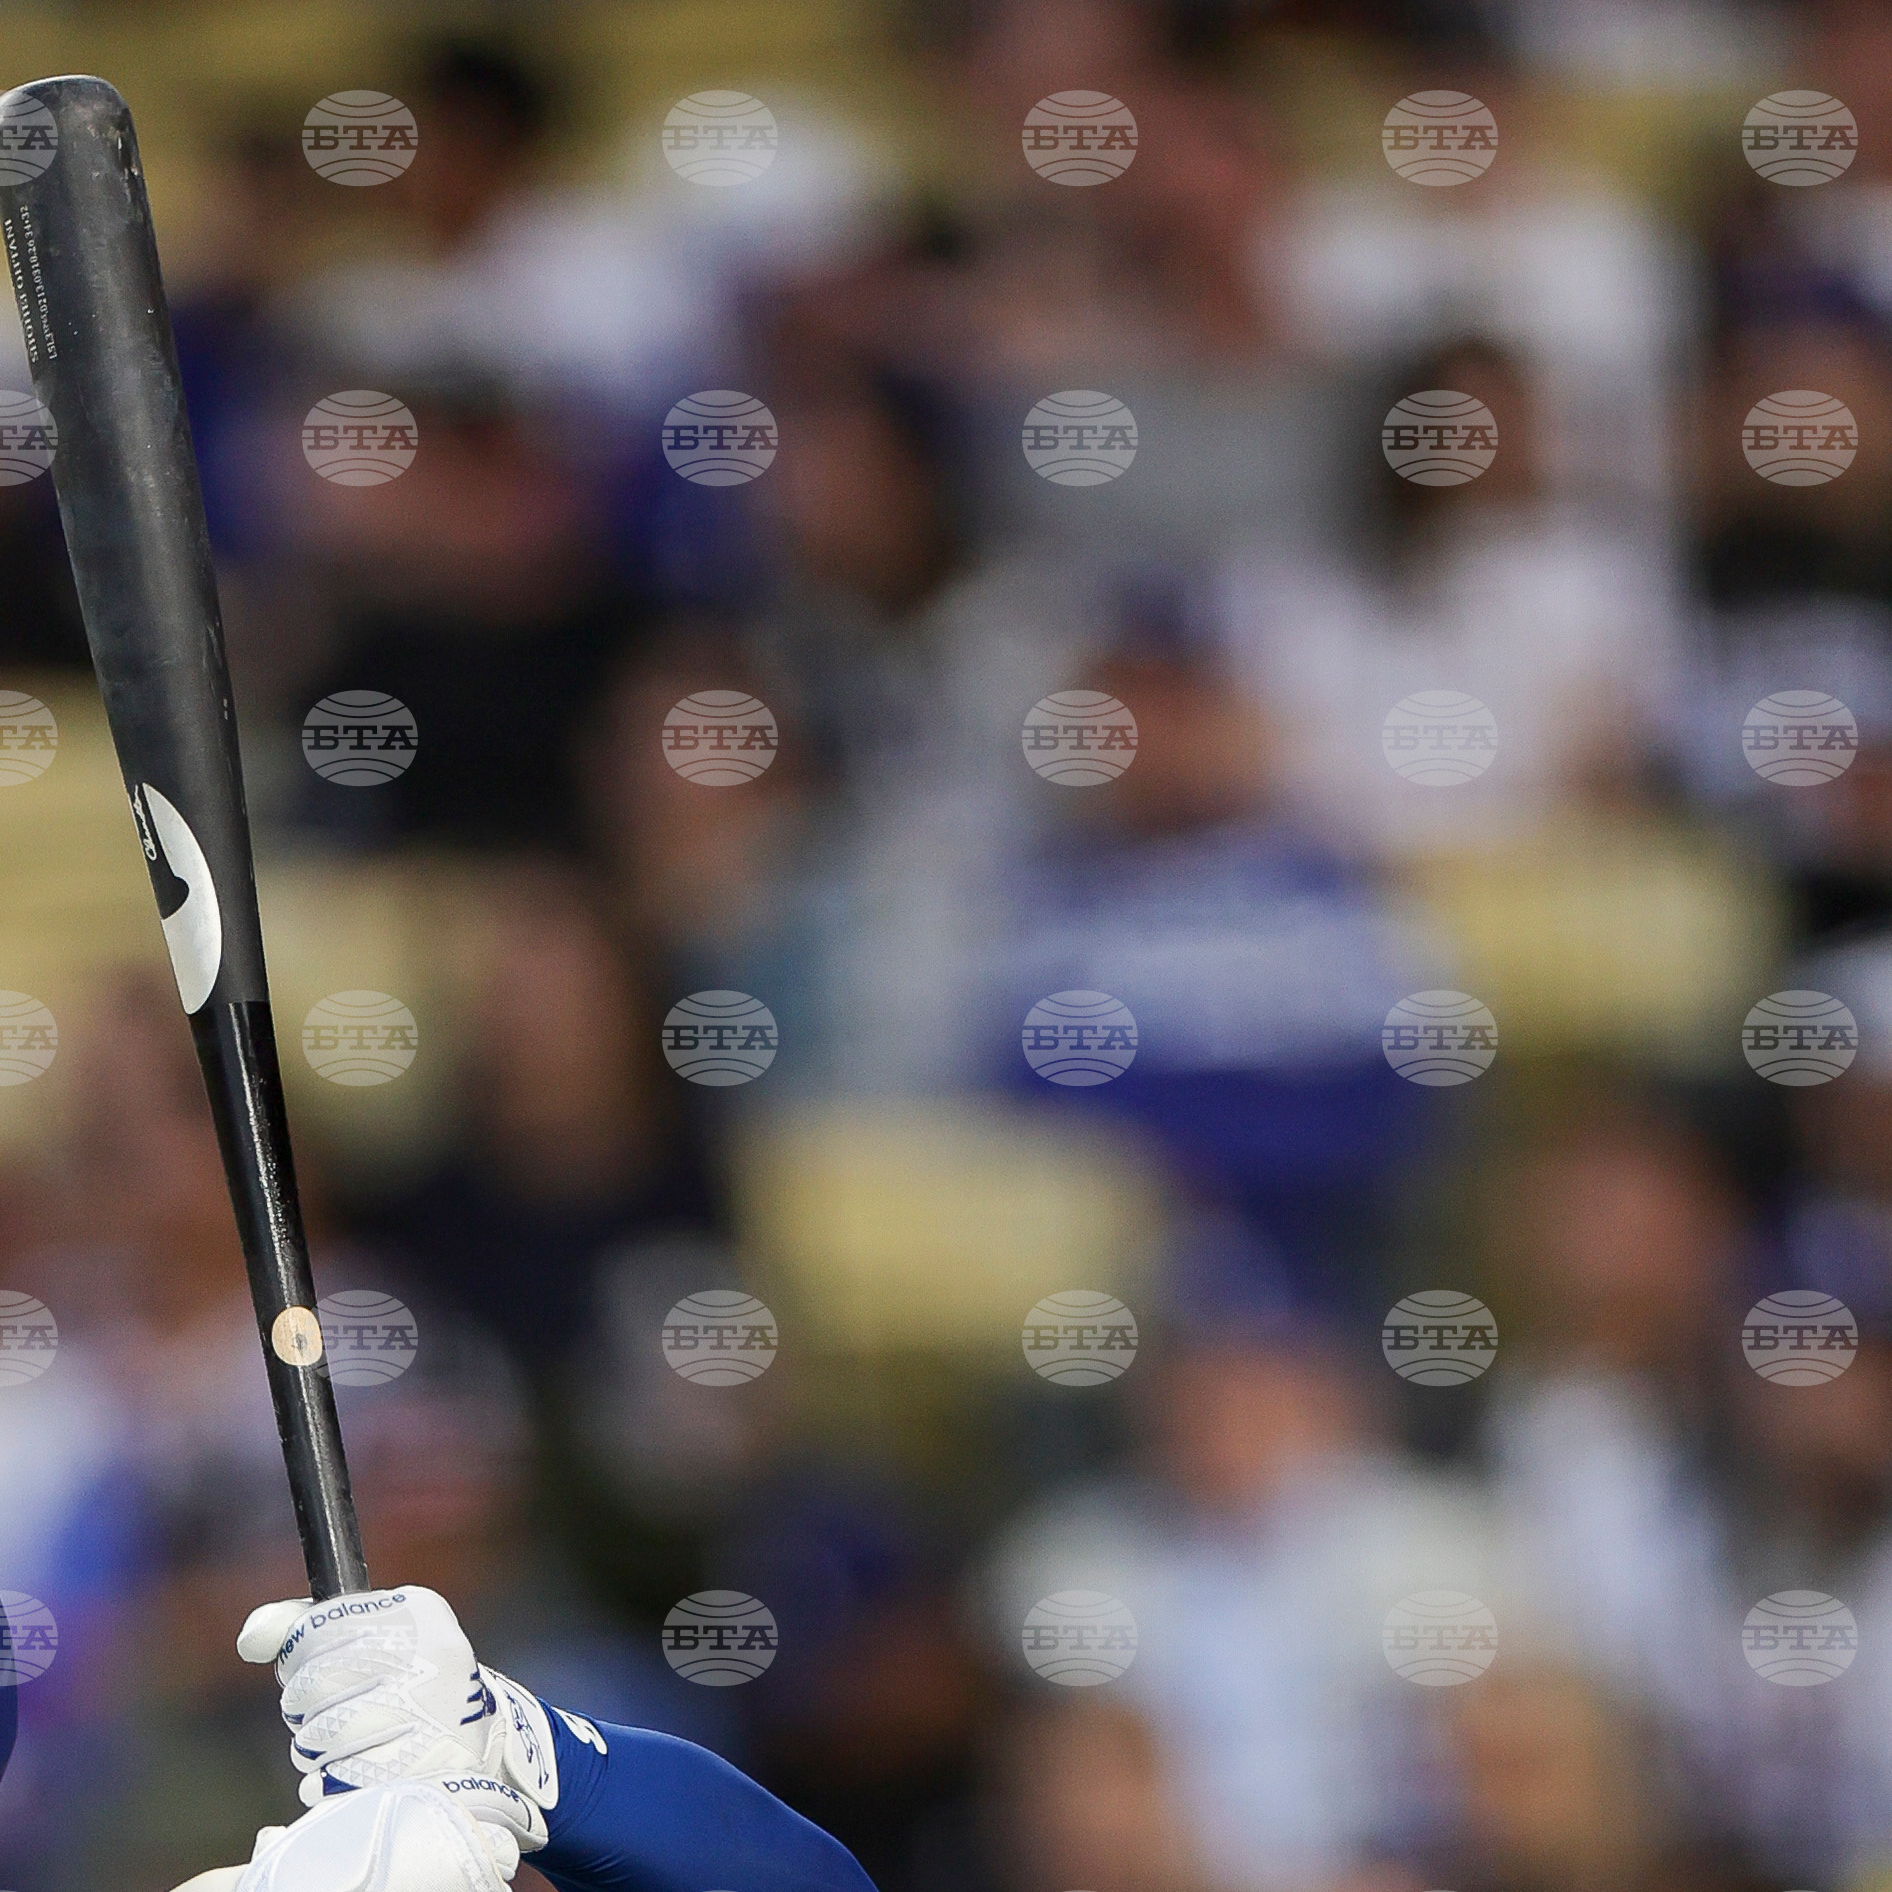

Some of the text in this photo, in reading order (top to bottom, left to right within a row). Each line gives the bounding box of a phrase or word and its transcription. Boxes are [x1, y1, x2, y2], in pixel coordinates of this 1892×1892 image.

[278, 1593, 407, 1665] new balance
[442, 1777, 519, 1803] balance
